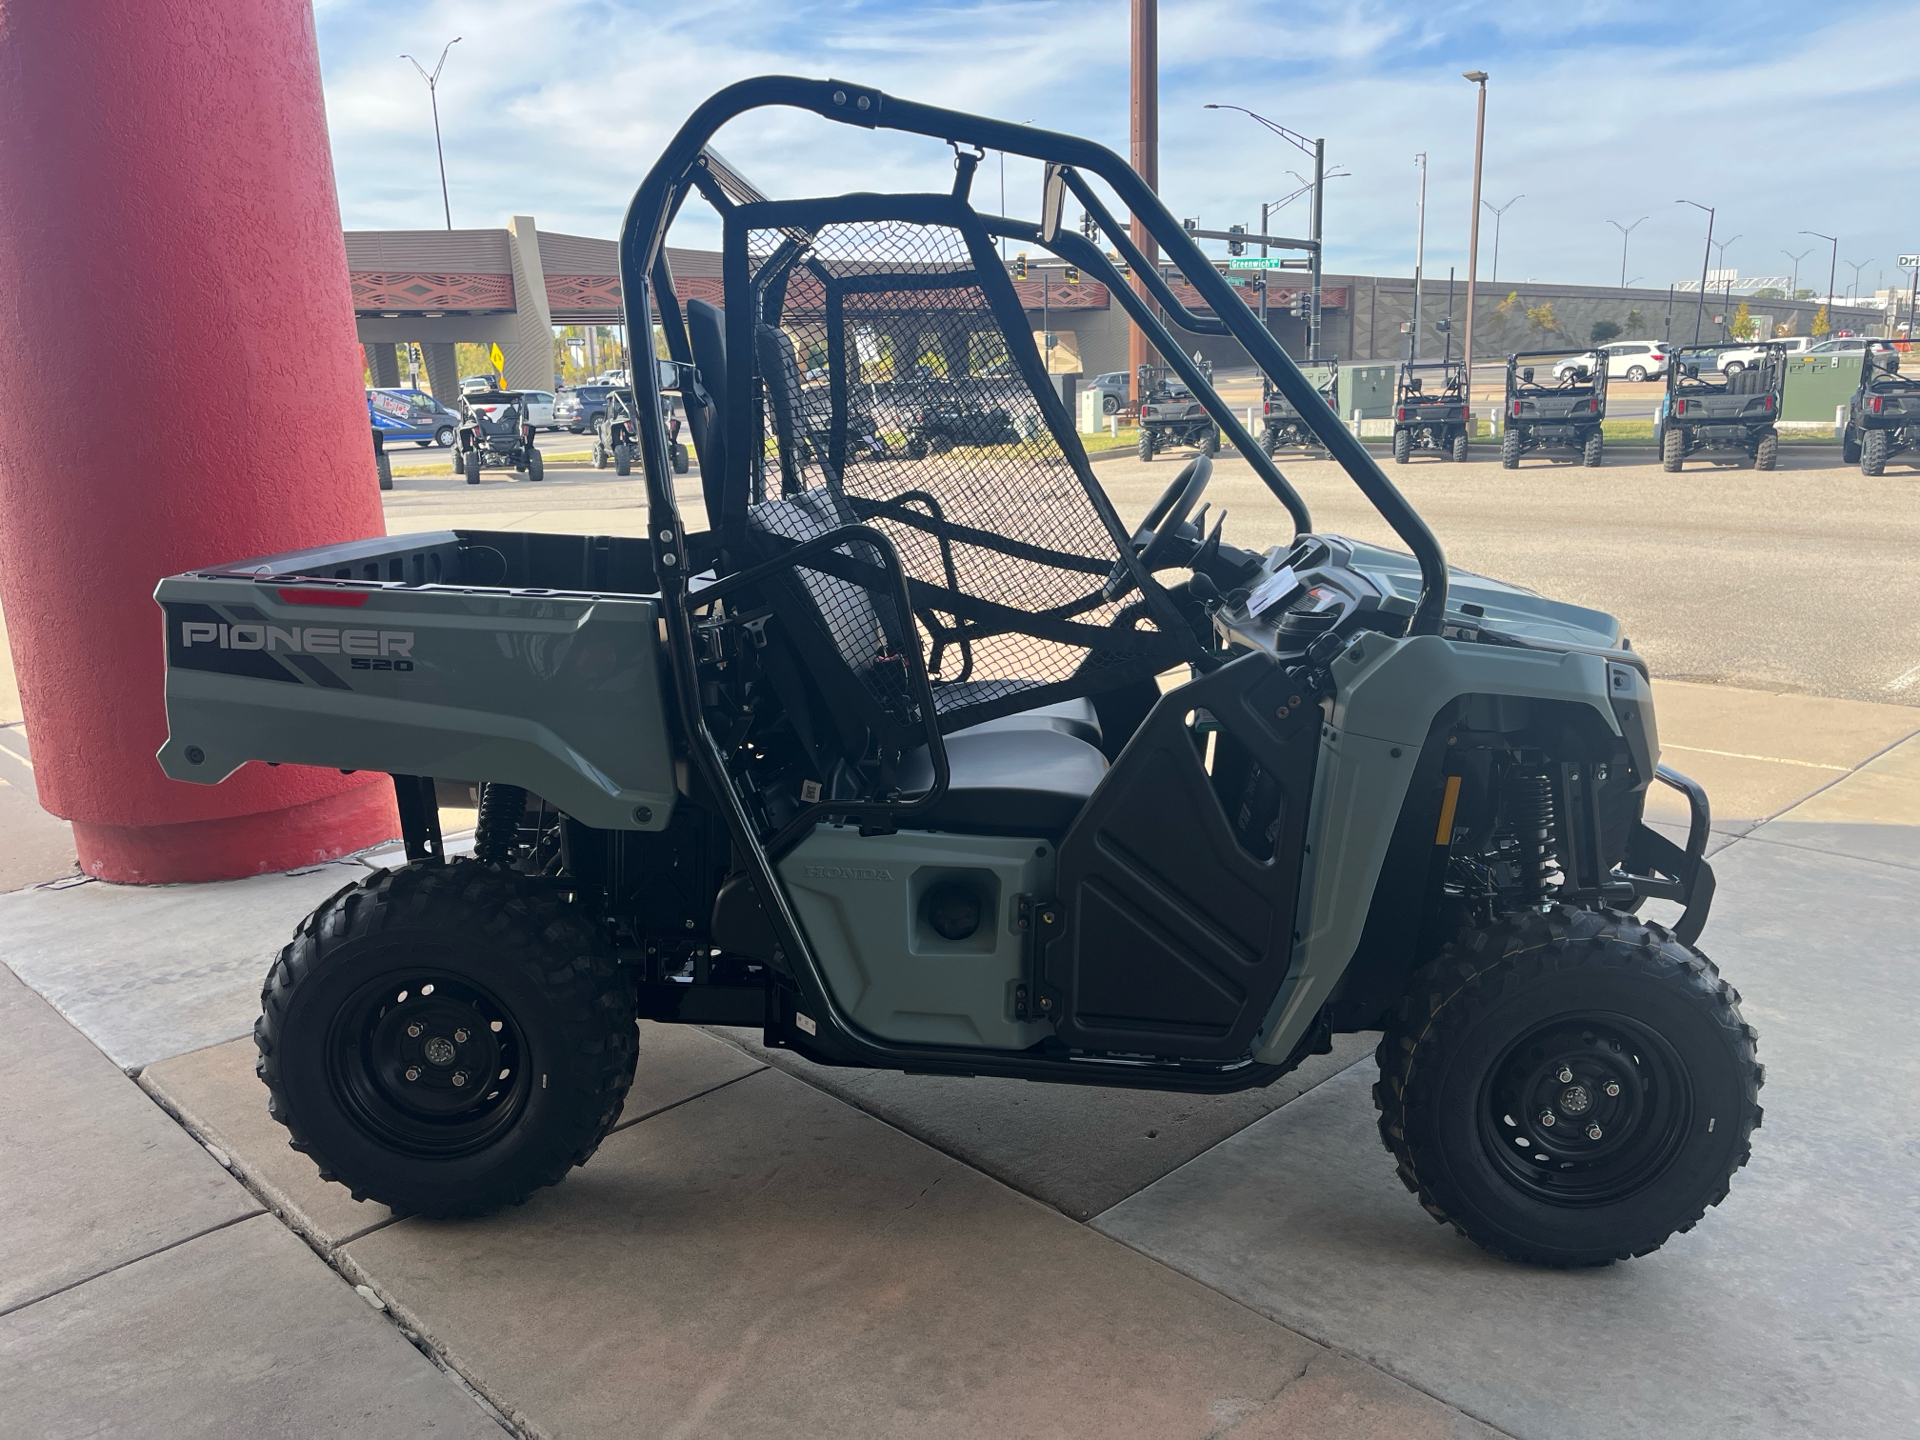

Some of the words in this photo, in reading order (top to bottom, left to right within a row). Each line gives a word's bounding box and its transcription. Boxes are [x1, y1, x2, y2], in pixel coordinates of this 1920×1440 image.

[1231, 260, 1270, 268] Greenwich
[182, 621, 414, 657] PIONEER
[350, 657, 414, 672] 520
[804, 866, 894, 881] HONDA
